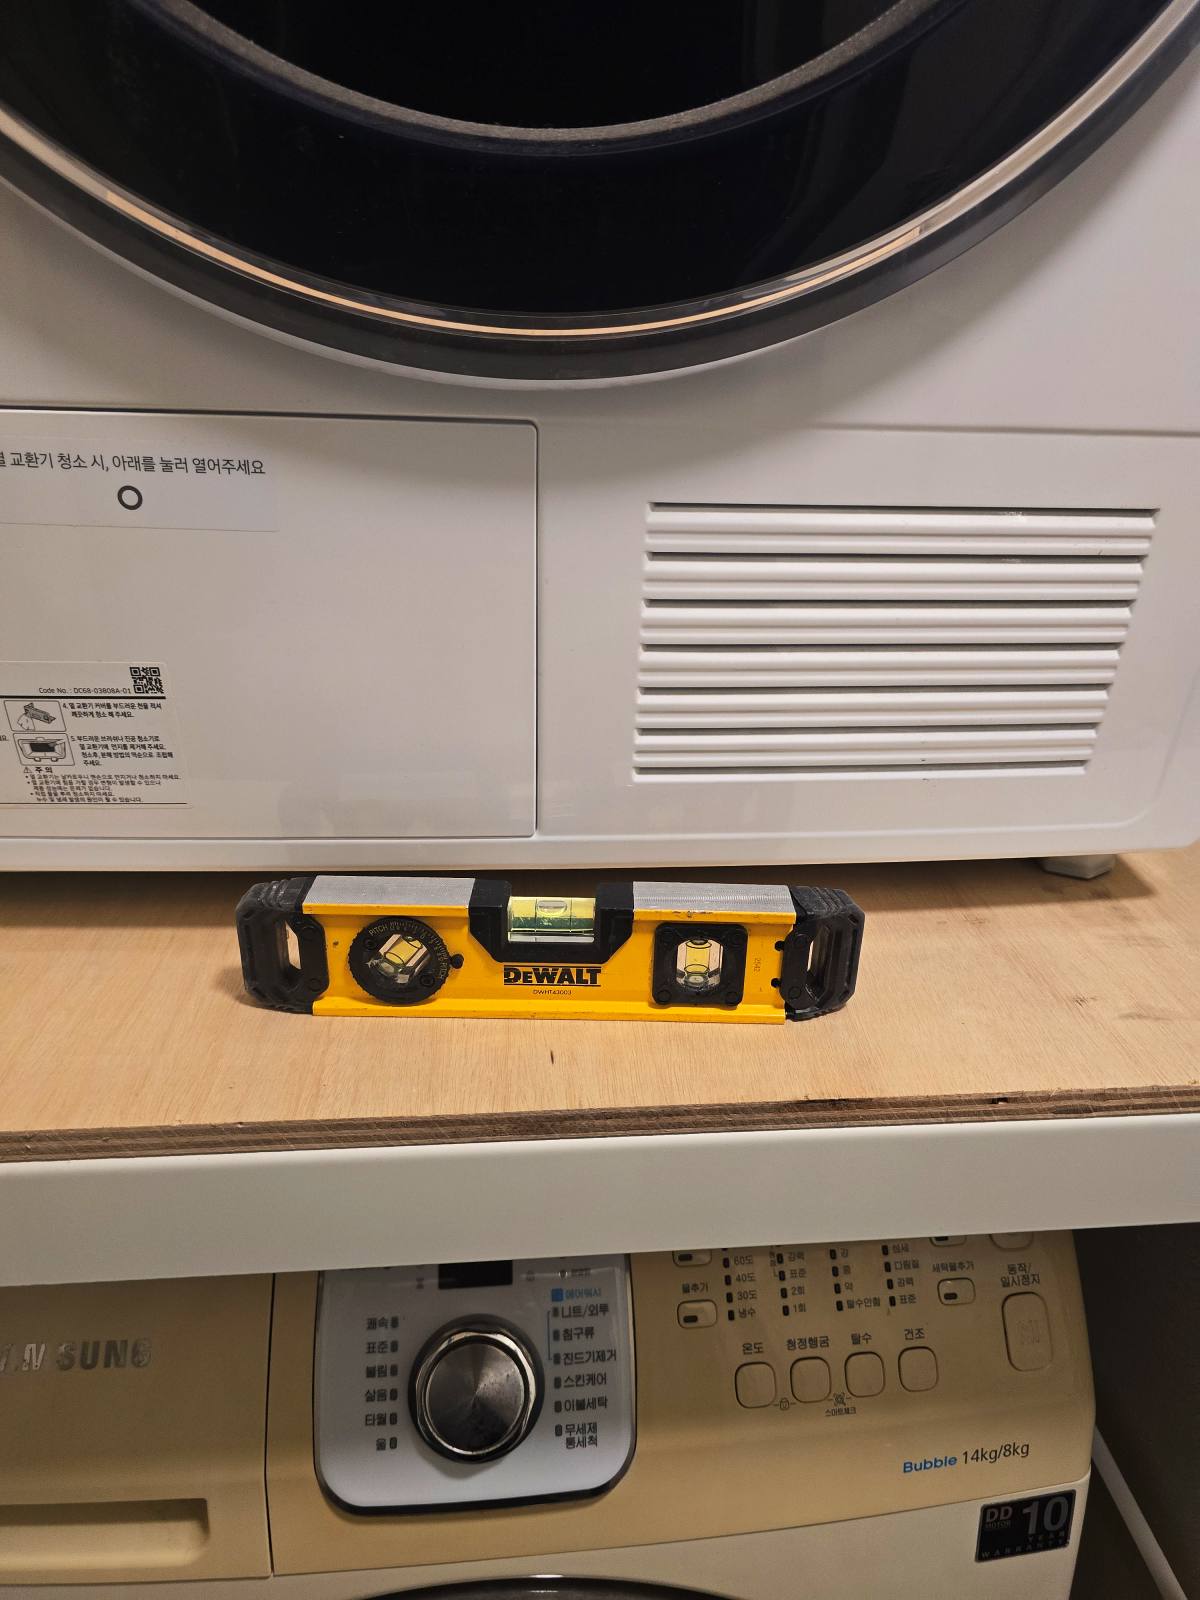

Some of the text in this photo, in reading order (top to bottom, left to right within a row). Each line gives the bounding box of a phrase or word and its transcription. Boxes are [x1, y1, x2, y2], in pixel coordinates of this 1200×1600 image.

[10, 452, 54, 469] 교환기
[57, 453, 88, 470] 청소
[91, 454, 109, 472] 시,
[112, 455, 156, 473] 아래를
[159, 457, 188, 474] 눌러
[192, 458, 266, 475] 열어주세요
[368, 925, 388, 936] PITCH
[736, 1272, 756, 1282] 40도
[1000, 1273, 1041, 1288] 일시정지
[737, 1290, 758, 1301] 30도
[561, 1303, 609, 1318] 니트/외투
[739, 1307, 756, 1319] 냉수
[563, 1326, 594, 1341] 침구류
[851, 1332, 872, 1345] 탈수
[904, 1328, 926, 1341] 건조
[366, 1341, 388, 1353] 표준
[742, 1342, 764, 1355] 온도
[563, 1349, 617, 1366] 진드기제거
[564, 1372, 607, 1388] 스킨케어
[564, 1396, 608, 1411] 이불세탁
[565, 1422, 598, 1436] 무세제
[566, 1435, 598, 1449] 통세척
[903, 1442, 1030, 1473] Bubble 14kg/8kg
[986, 1505, 1013, 1522] DD
[1022, 1496, 1069, 1535] 10
